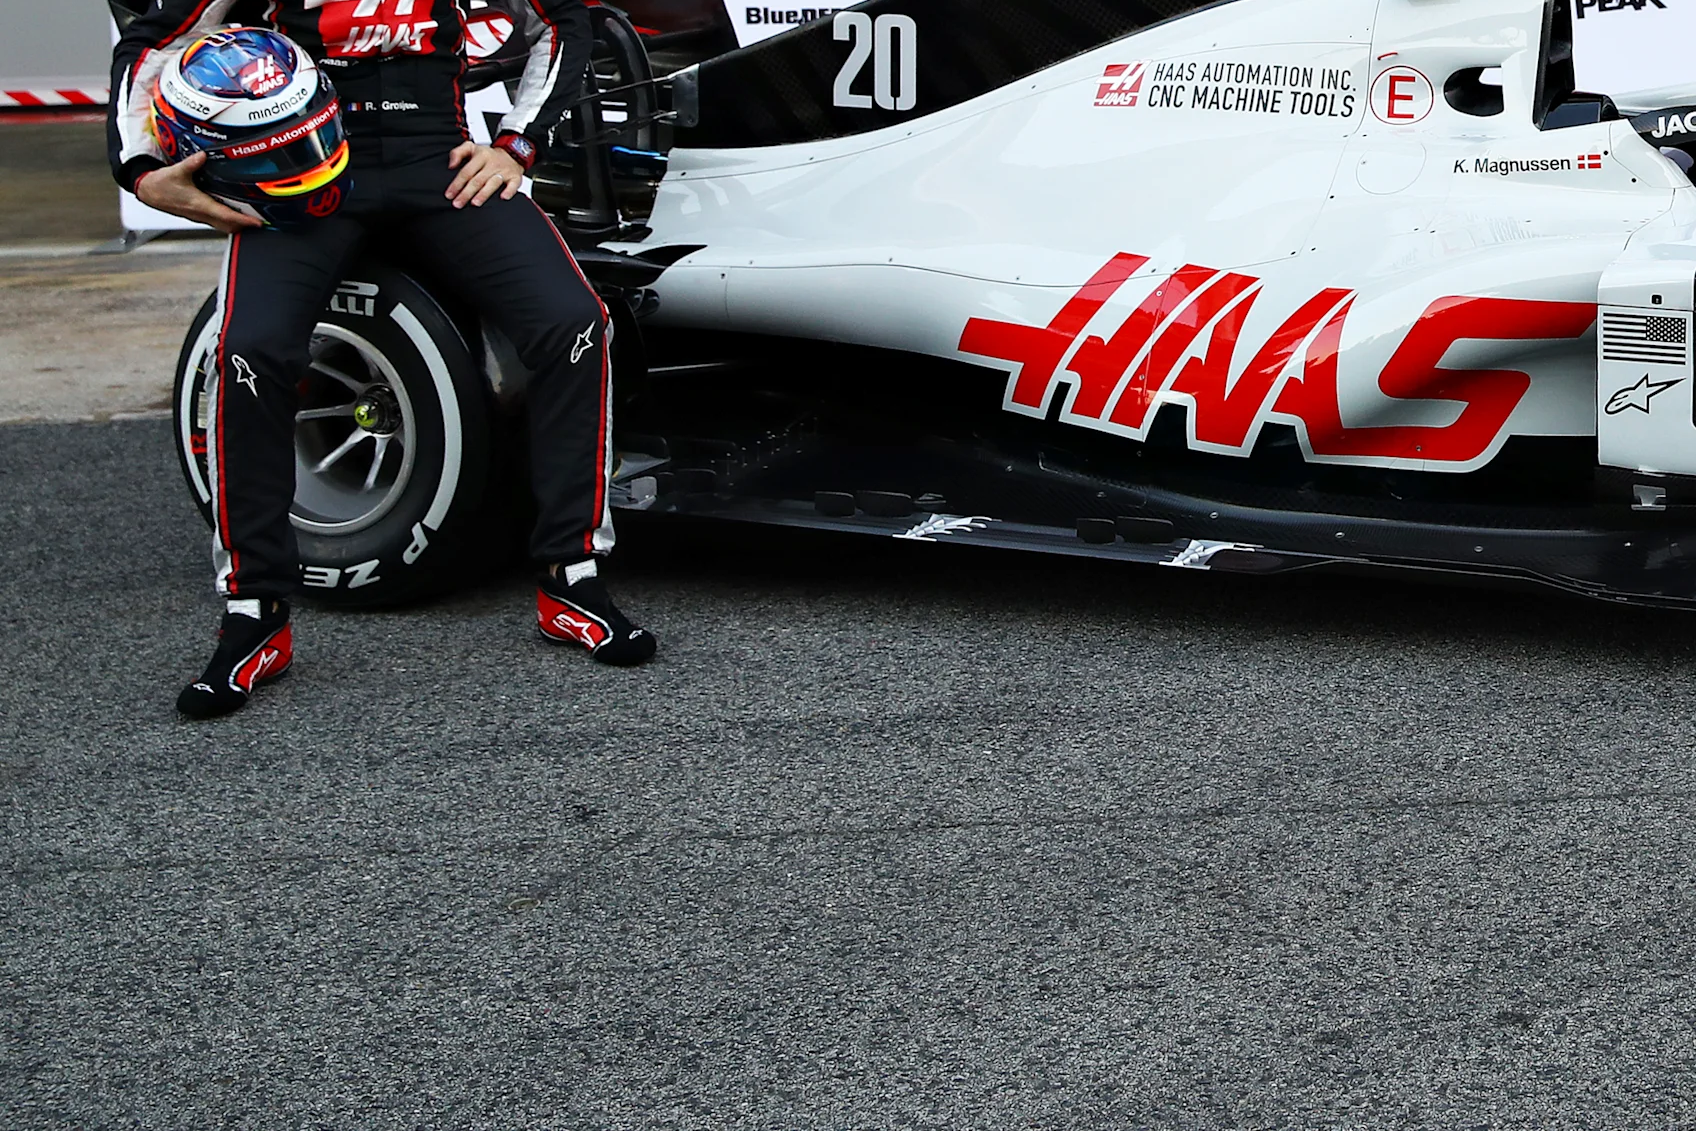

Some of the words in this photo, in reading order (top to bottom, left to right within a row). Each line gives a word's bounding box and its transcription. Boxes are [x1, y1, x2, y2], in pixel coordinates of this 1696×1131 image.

[746, 6, 845, 25] BlueD
[323, 20, 438, 53] HAAS
[833, 11, 917, 110] 20
[1153, 62, 1197, 82] HAAS
[1200, 63, 1313, 89] AUTOMATION
[1320, 68, 1357, 92] INC.
[253, 74, 287, 96] HAAS
[1095, 92, 1140, 106] HAAS
[1148, 85, 1186, 108] CNC
[1191, 86, 1283, 113] MACHINE
[1290, 91, 1357, 118] TOOLS
[1387, 74, 1416, 119] E
[248, 87, 309, 121] mindmaze
[232, 142, 267, 156] Haas
[270, 112, 331, 146] Automation
[1453, 158, 1469, 174] K.
[1474, 157, 1571, 176] Magnussen
[958, 252, 1597, 461] HAAS
